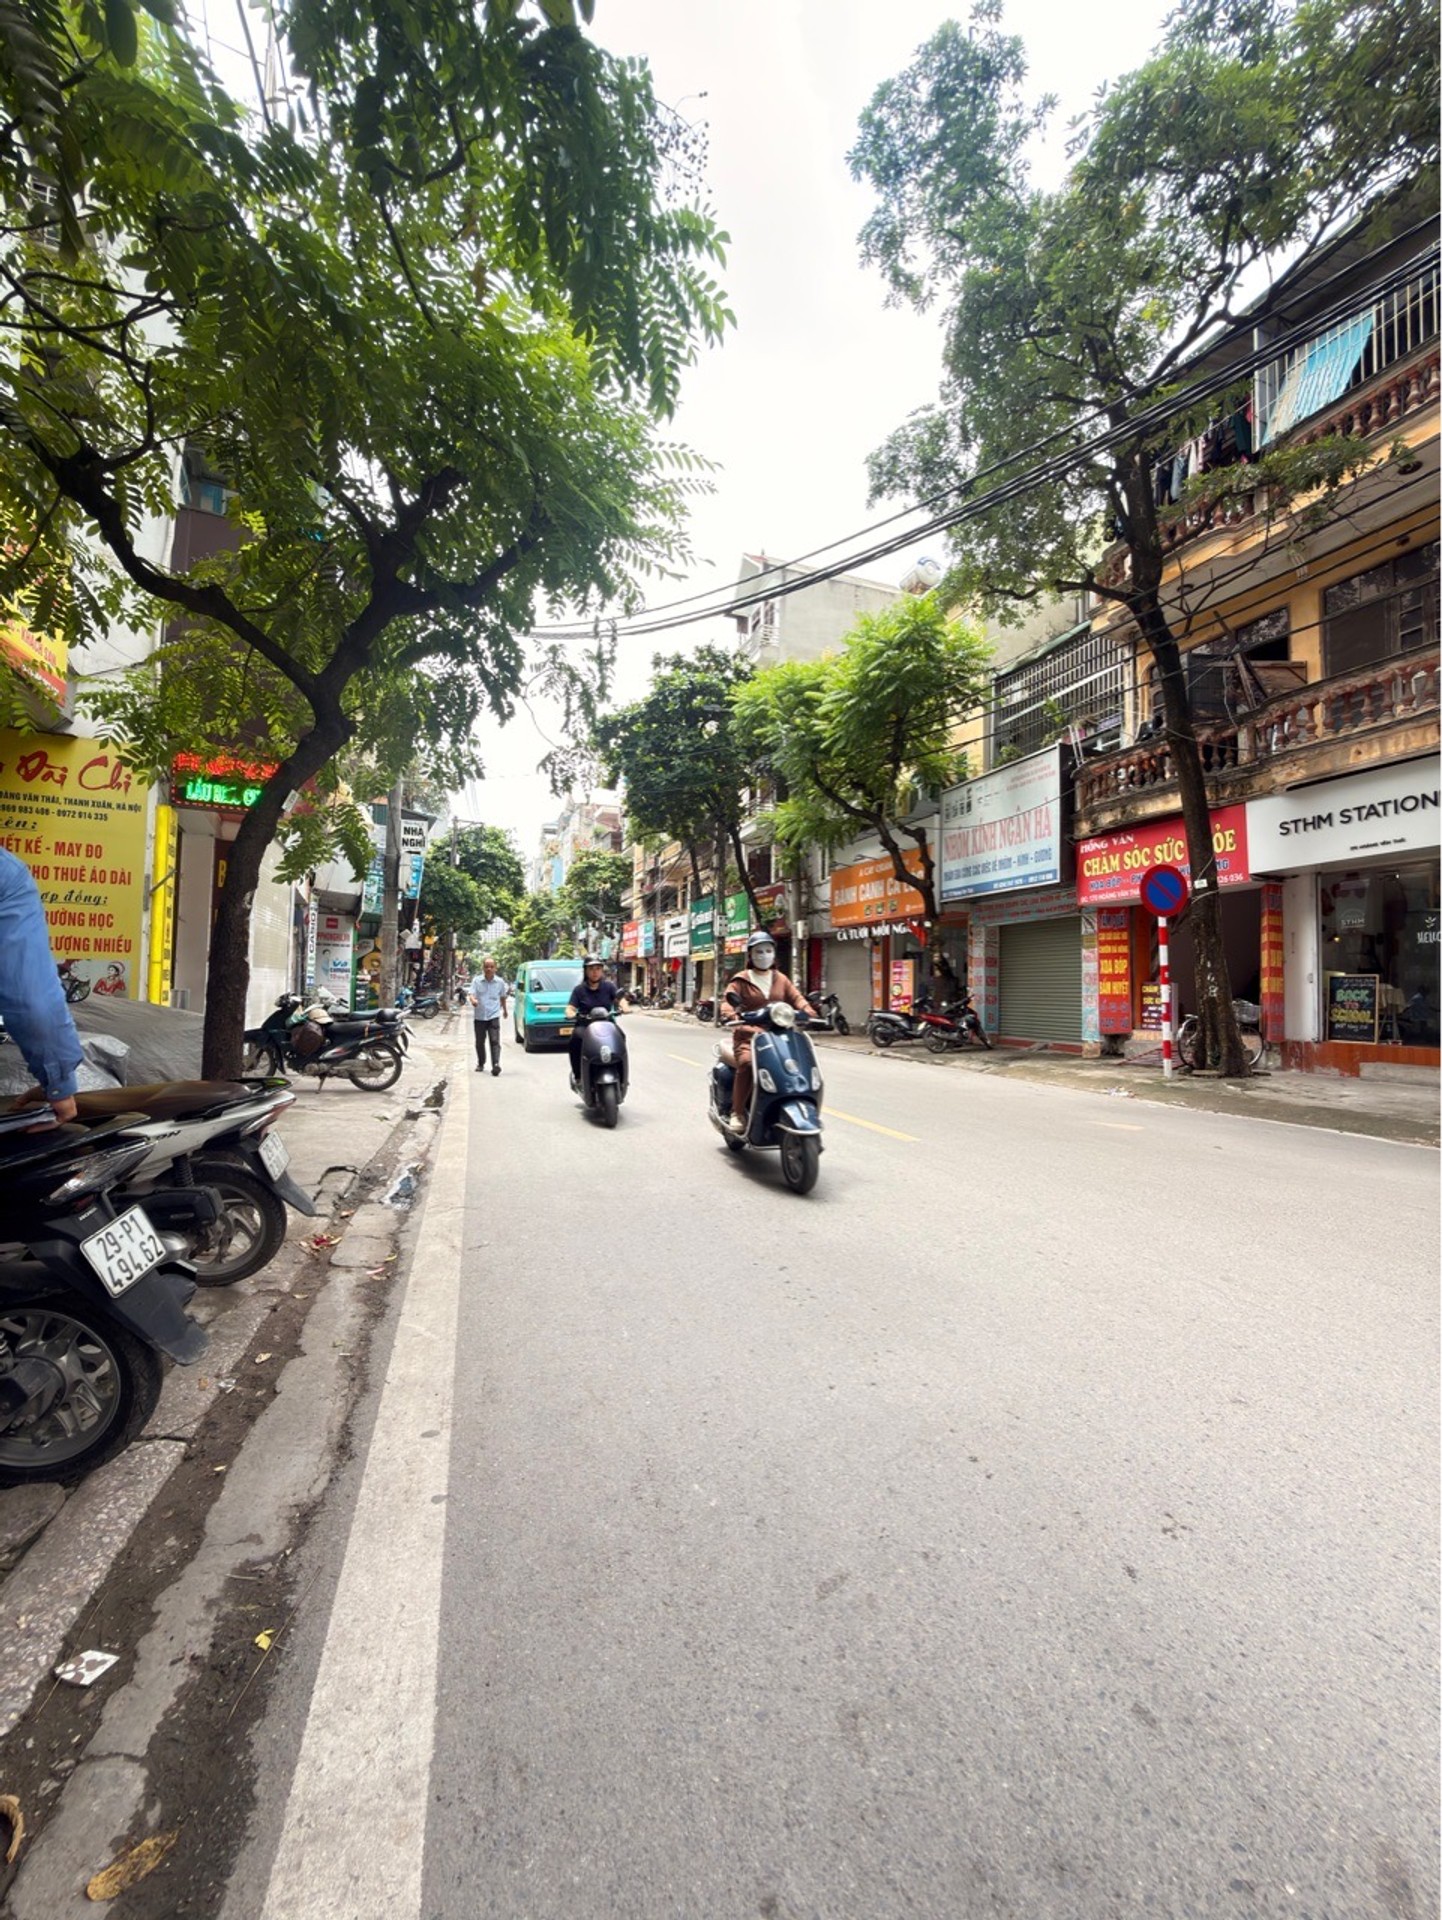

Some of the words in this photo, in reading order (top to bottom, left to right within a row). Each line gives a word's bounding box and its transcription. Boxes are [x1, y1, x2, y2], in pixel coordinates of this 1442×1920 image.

[1000, 805, 1031, 849] NGÂN
[1034, 797, 1052, 840] HÀ
[1279, 812, 1333, 837] STHM
[1339, 789, 1440, 825] STATION
[24, 835, 43, 854] KẾ
[54, 841, 82, 858] MAY
[85, 844, 103, 859] ĐO
[1083, 851, 1120, 877] CHĂM
[1123, 844, 1151, 870] SÓC
[1154, 836, 1184, 864] SỨC
[1212, 824, 1237, 854] ỎE
[29, 865, 49, 880] HO
[53, 865, 86, 882] THUÊ
[89, 866, 107, 884] ÁO
[110, 868, 131, 885] DÀI
[88, 913, 114, 931] HỌC
[1335, 989, 1370, 1002] BACK
[96, 1214, 145, 1262] 29-P1
[107, 1234, 164, 1288] 494.62
